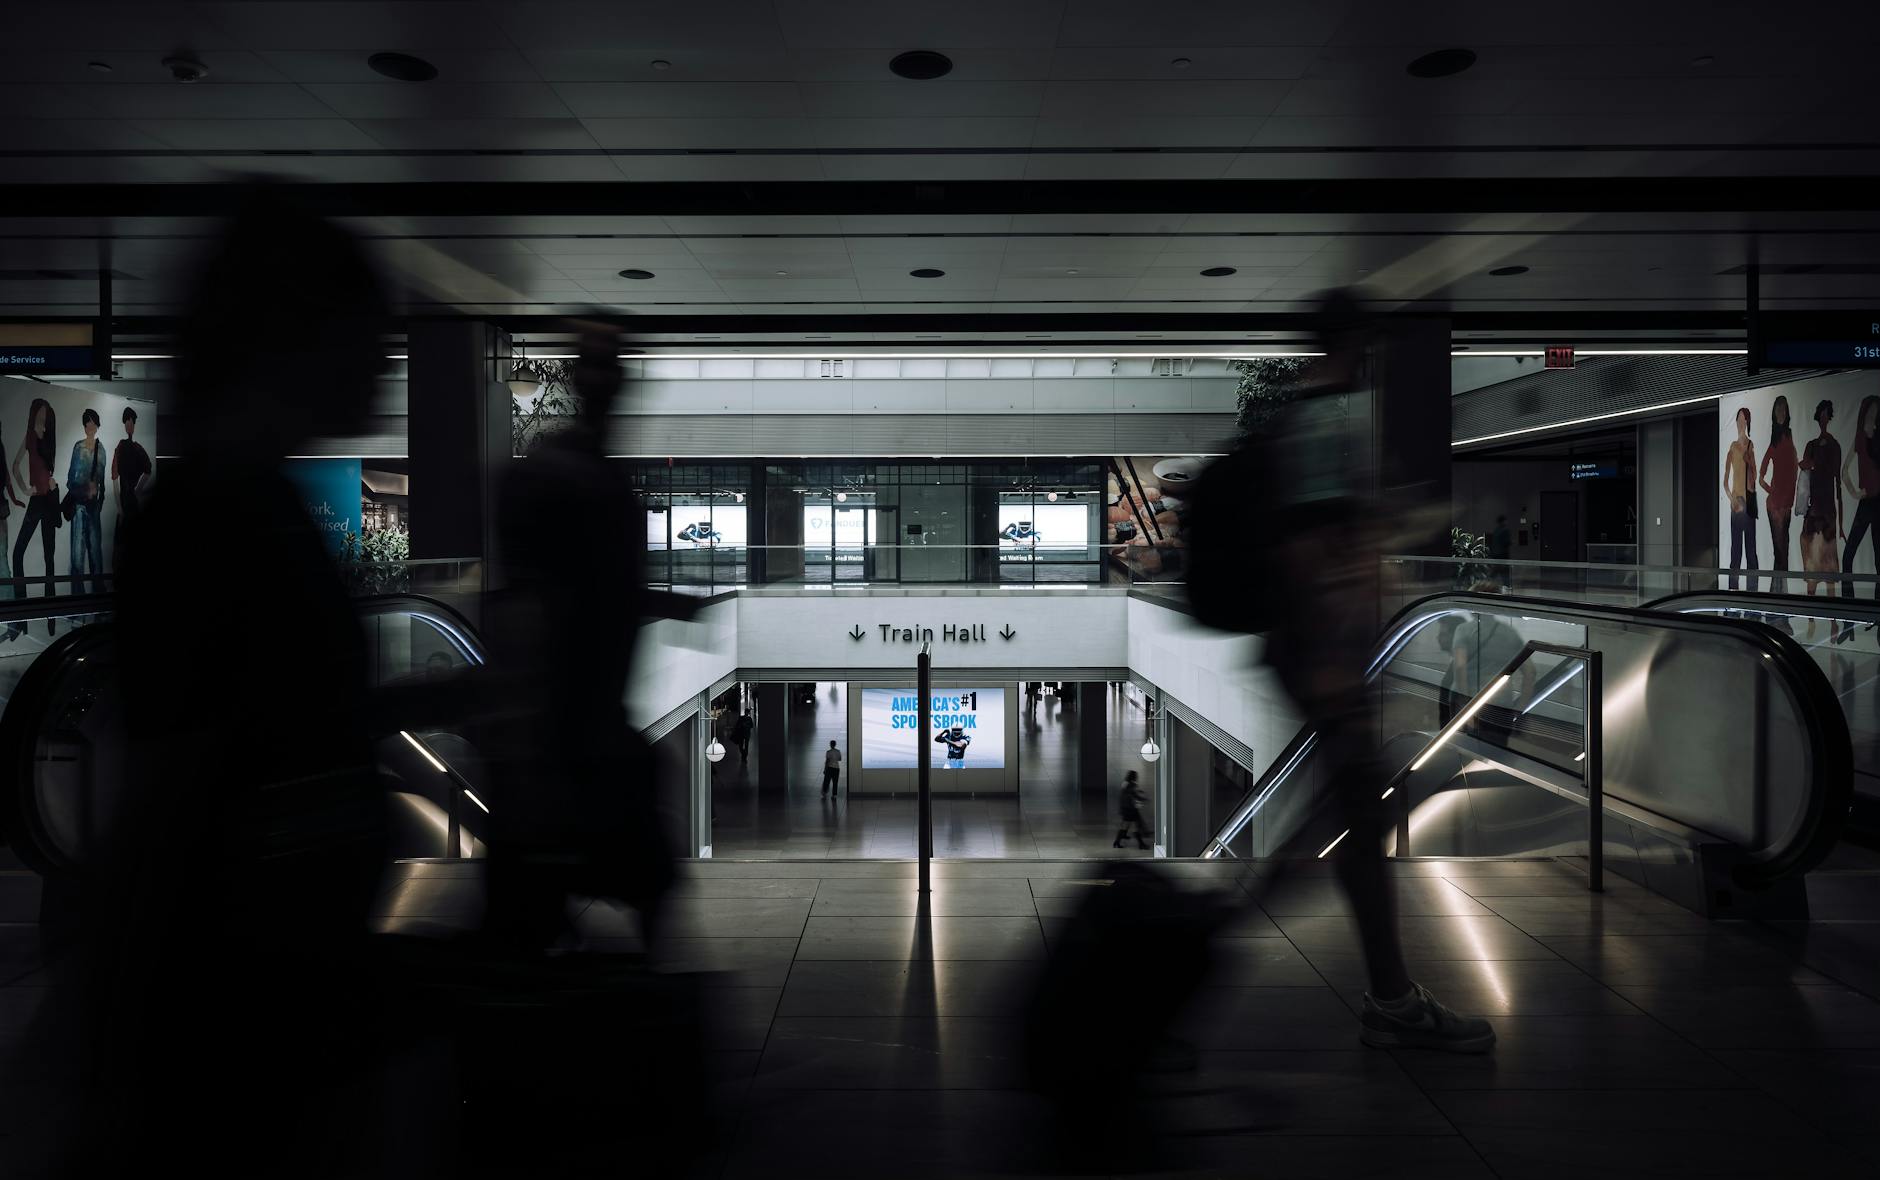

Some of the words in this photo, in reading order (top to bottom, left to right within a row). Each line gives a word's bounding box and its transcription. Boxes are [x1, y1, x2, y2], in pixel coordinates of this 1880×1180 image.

[11, 355, 46, 364] Services
[1549, 348, 1573, 367] EXIT
[1854, 346, 1880, 358] 31st
[878, 624, 933, 642] Train
[943, 624, 986, 642] Hall
[891, 696, 960, 711] AMECA'S
[960, 692, 977, 711] #1
[891, 714, 977, 729] SPOSBOOK
